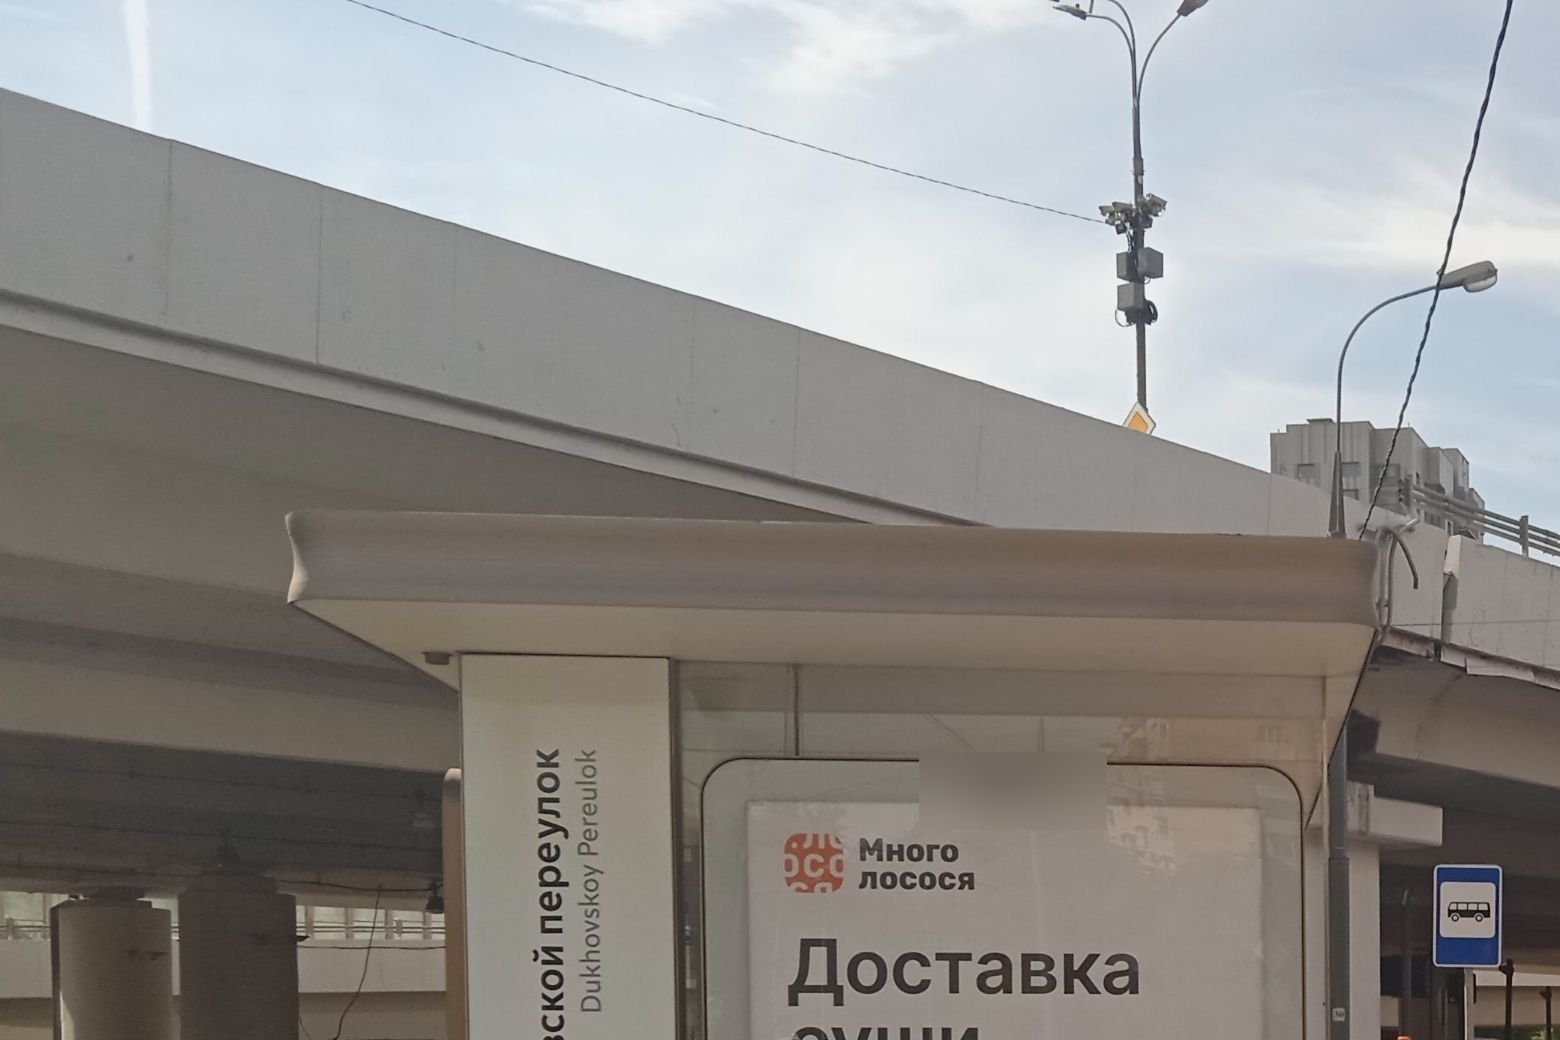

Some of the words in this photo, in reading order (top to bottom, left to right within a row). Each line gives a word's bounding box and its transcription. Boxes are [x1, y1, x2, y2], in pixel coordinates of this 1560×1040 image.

[536, 748, 569, 934] переулок
[575, 749, 598, 857] Pereulok
[859, 838, 959, 862] Много
[859, 871, 975, 890] лосося
[579, 864, 604, 1012] Dukhovskoy
[788, 938, 1140, 1007] Доставка
